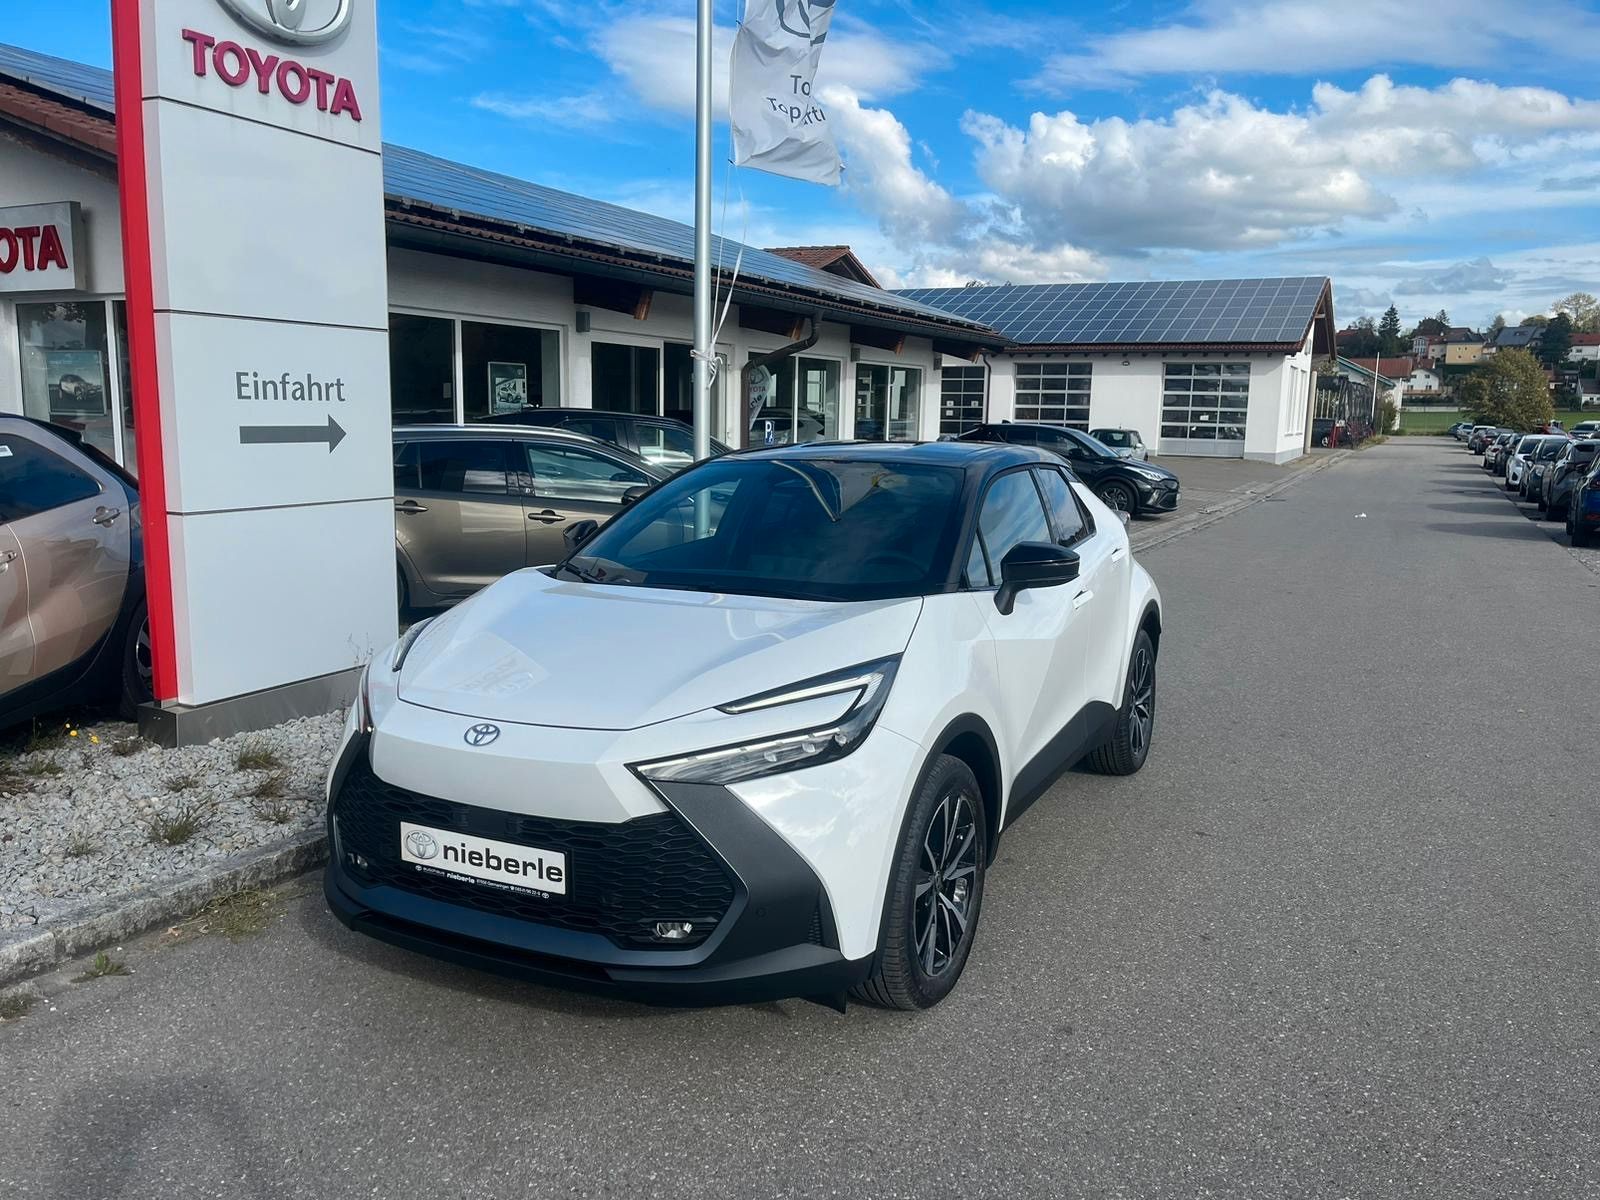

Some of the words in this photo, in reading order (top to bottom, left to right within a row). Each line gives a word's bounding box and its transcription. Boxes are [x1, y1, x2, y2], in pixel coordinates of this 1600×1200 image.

[181, 28, 362, 122] TOYOTA
[0, 225, 69, 273] OTA
[235, 371, 346, 402] Einfahrt
[443, 843, 563, 883] nieberle
